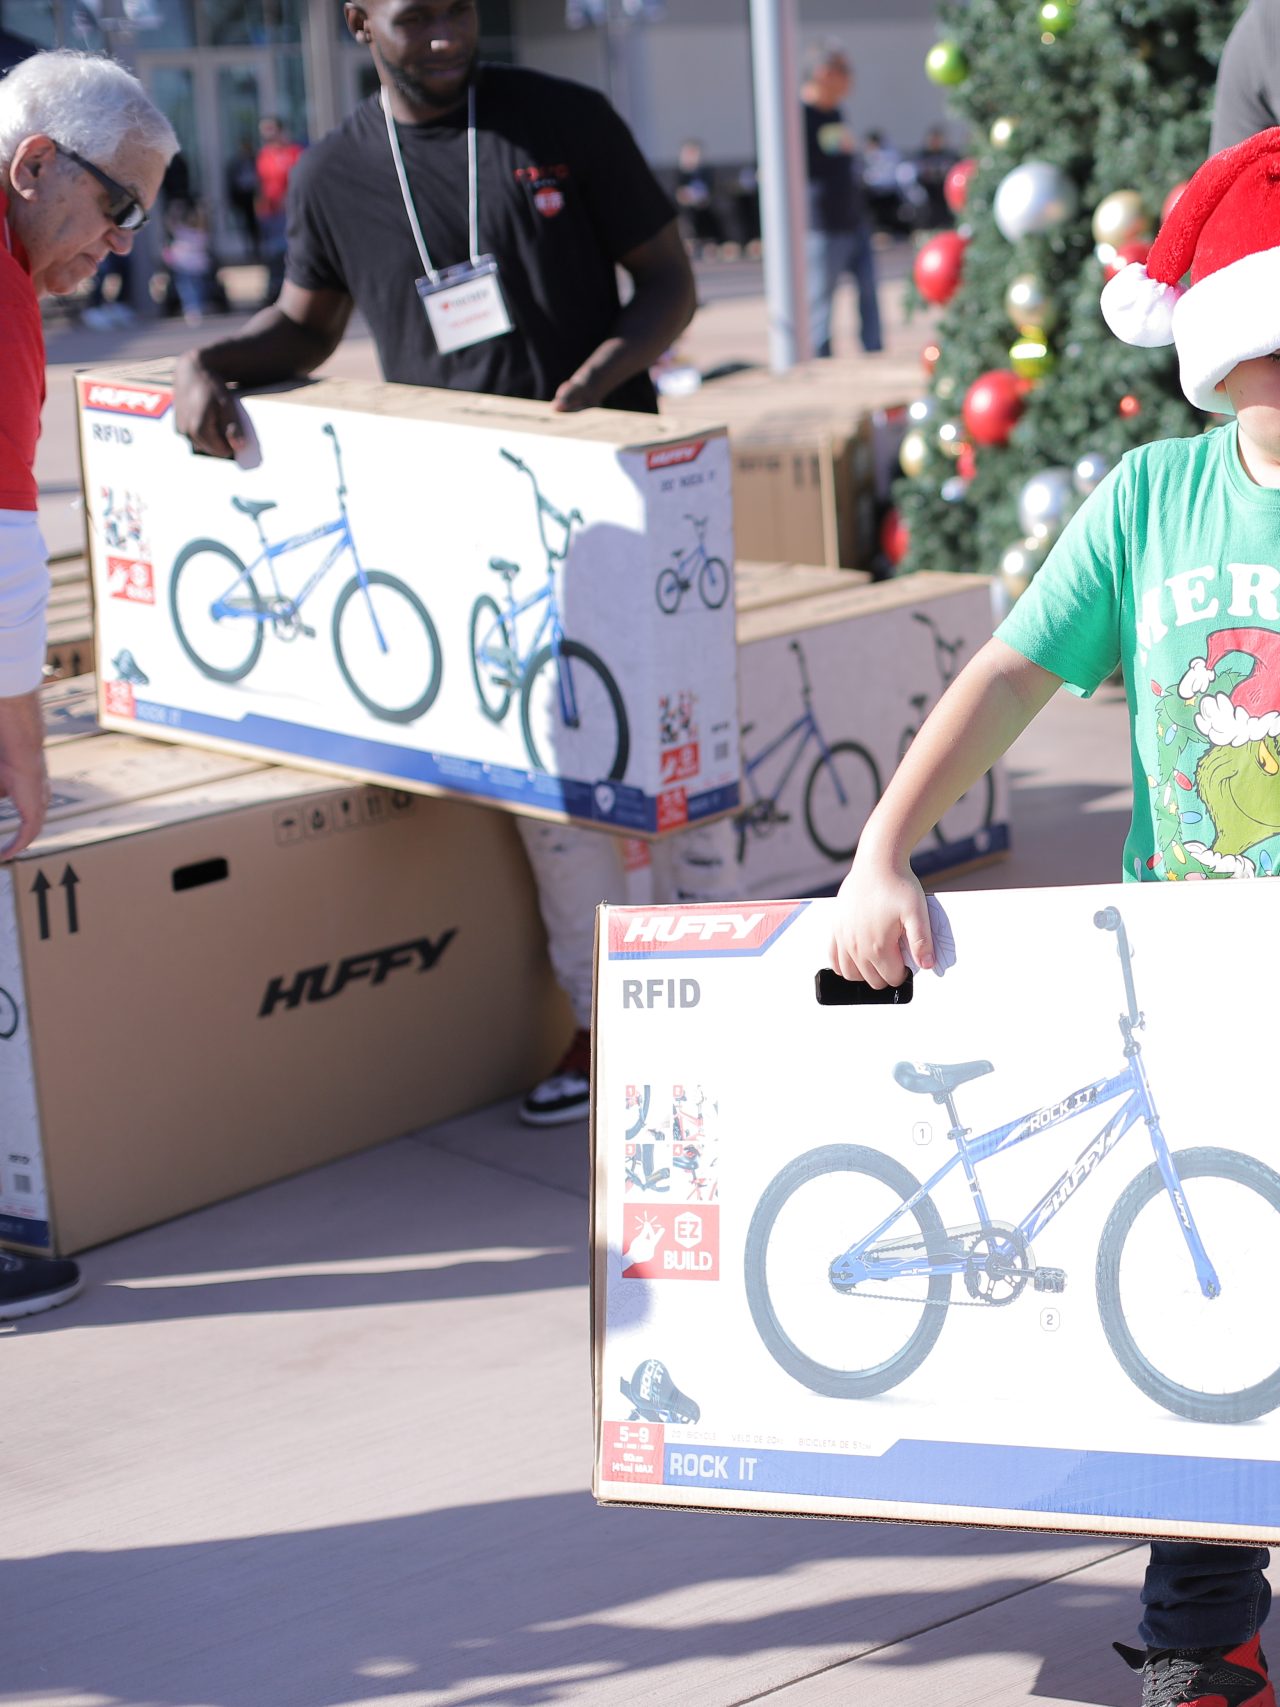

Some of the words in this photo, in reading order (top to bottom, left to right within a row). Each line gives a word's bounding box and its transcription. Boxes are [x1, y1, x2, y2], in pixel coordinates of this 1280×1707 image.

[92, 423, 134, 445] RFID
[623, 913, 767, 943] HUFFY
[257, 926, 460, 1019] HUFFY
[622, 978, 701, 1009] RFID
[1028, 1099, 1070, 1133] ROCK
[1073, 1087, 1094, 1109] IT
[1049, 1132, 1114, 1211] HUFFY
[677, 1221, 700, 1239] EZ
[663, 1250, 713, 1271] BUILD
[639, 1359, 658, 1401] ROCK
[798, 1437, 837, 1448] BICICLETA
[839, 1440, 850, 1449] DE
[634, 1463, 654, 1474] MAX
[669, 1452, 729, 1480] ROCK
[738, 1457, 758, 1481] IT
